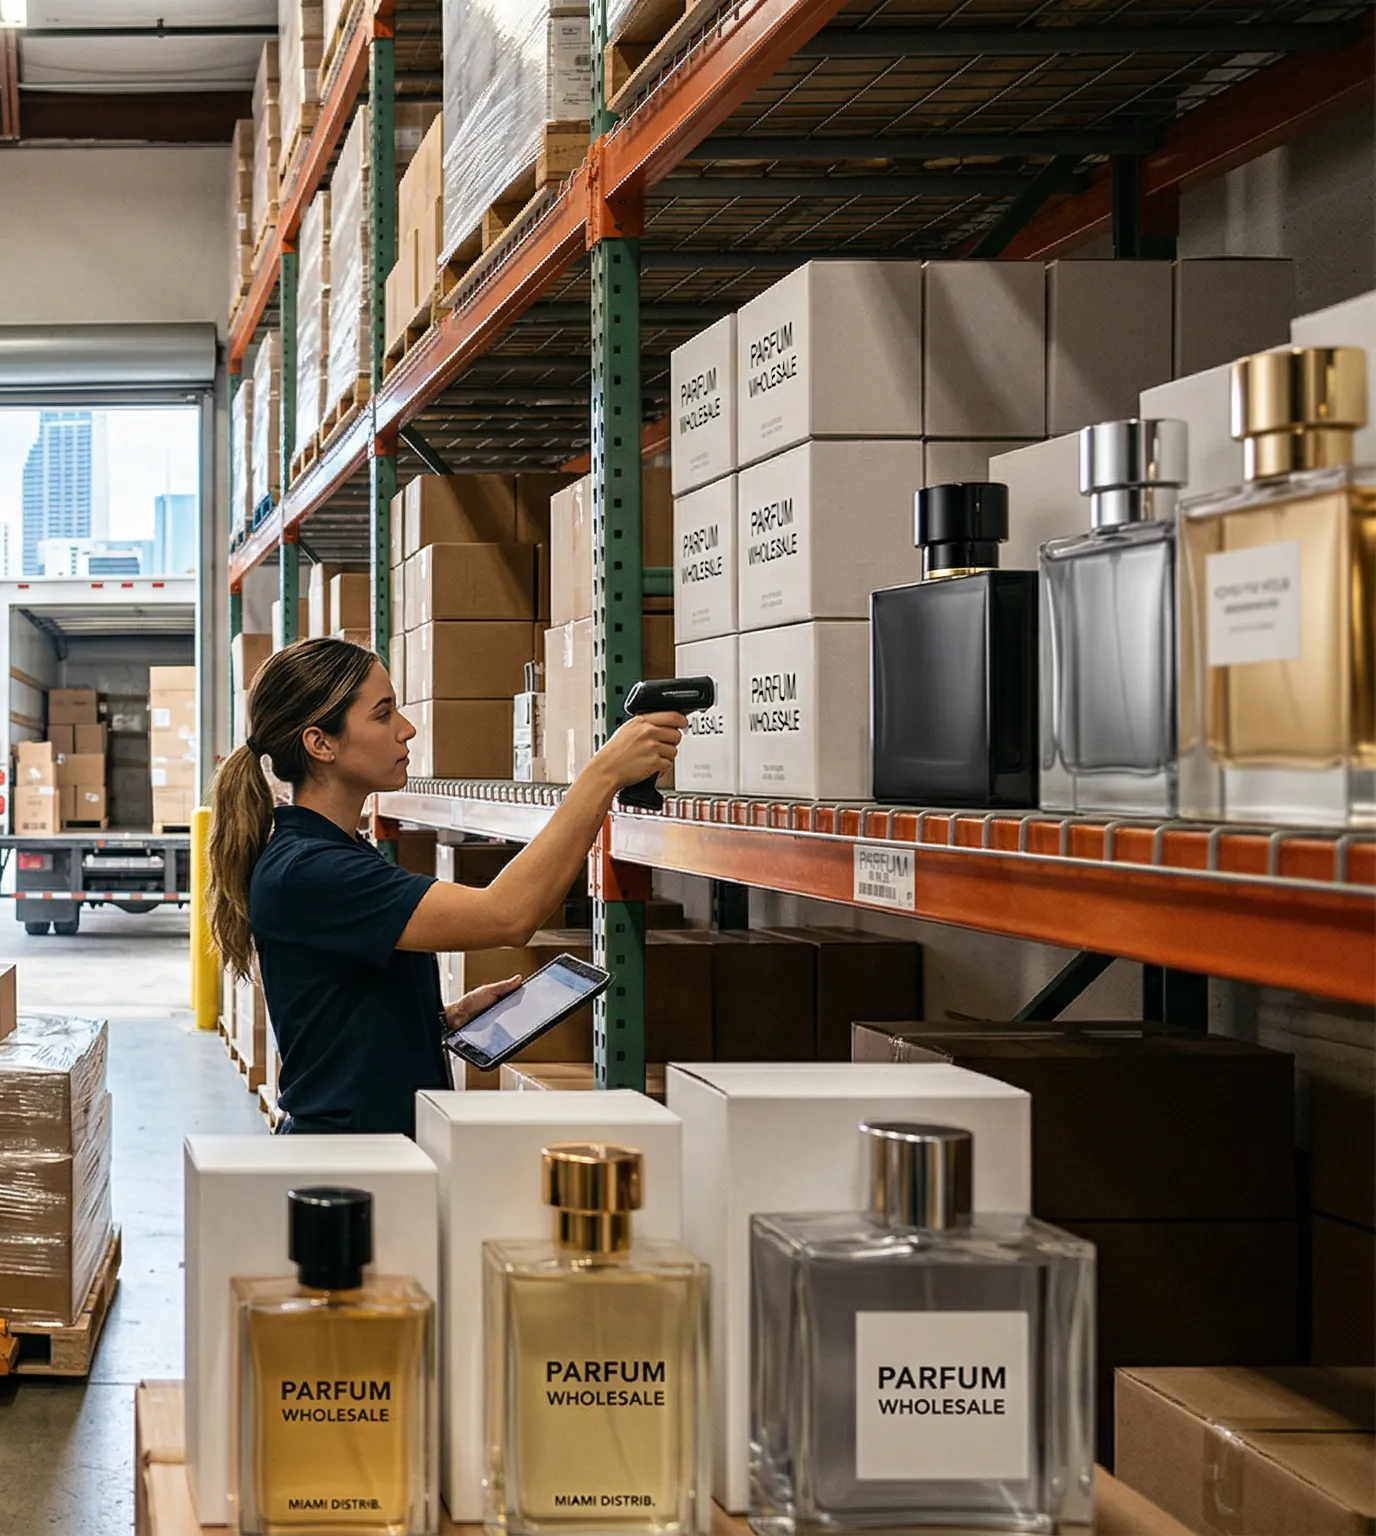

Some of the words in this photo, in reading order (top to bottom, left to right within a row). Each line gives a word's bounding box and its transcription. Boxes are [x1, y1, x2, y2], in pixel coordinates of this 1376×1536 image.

[749, 322, 794, 369] PARFUM
[680, 367, 718, 408] PARFUM
[748, 355, 797, 398] WHOLESALE
[679, 398, 721, 435] WHOLESALE
[750, 498, 794, 537] PARFUM
[682, 524, 719, 559] PARFUM
[748, 533, 797, 566] WHOLESALE
[751, 673, 797, 704] PARFUM
[749, 709, 800, 732] WHOLESALE
[547, 1361, 665, 1382] PARFUM
[878, 1366, 1006, 1389] PARFUM
[281, 1381, 391, 1400] PARFUM
[547, 1391, 665, 1406] WHOLESALE
[282, 1409, 389, 1422] WHOLESALE
[878, 1399, 1005, 1414] WHOLESALE
[288, 1499, 328, 1510] MIAMI
[331, 1499, 382, 1510] DISTRIB.
[555, 1495, 596, 1506] MIAMI
[601, 1495, 655, 1507] DISTRIB.
